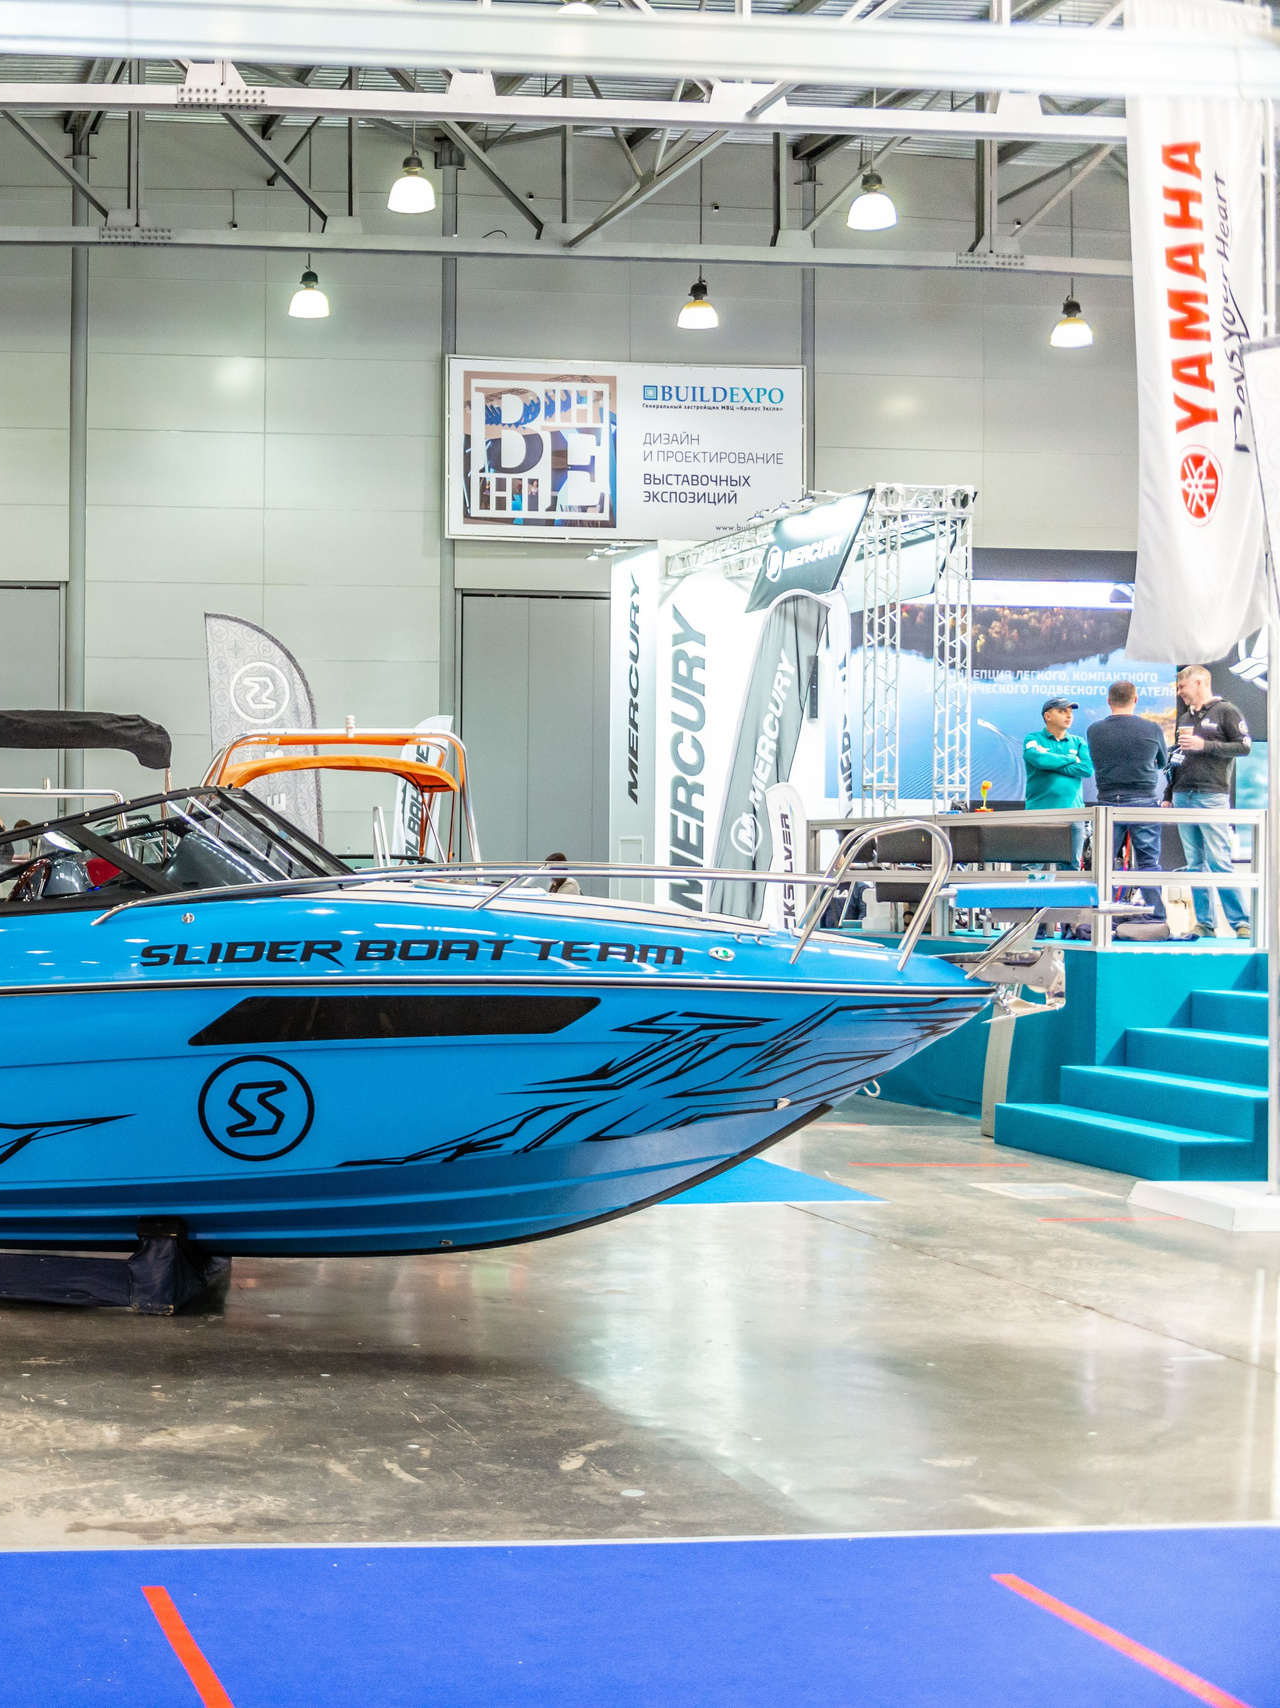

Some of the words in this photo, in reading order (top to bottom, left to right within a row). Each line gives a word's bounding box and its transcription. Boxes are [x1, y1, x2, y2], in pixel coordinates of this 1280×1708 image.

[1214, 169, 1231, 262] Heart
[1161, 141, 1219, 434] YAMAHA
[660, 385, 784, 404] BUILDEXPO
[643, 431, 700, 446] ДИЗАЙН
[643, 450, 653, 462] И
[657, 450, 783, 465] ПРОЕКТИРОВАНИЕ
[643, 473, 751, 487] ВЫСТАВОЧНЫХ
[643, 489, 738, 505] ЭКСПОЗИЦИЙ
[1073, 671, 1158, 683] КОМПАКТНОГО
[627, 571, 640, 805] MERCURY
[1032, 684, 1107, 697] ПОДВЕСНОГО
[749, 648, 796, 811] MERCURY
[669, 604, 706, 912] MERCURY
[140, 940, 345, 967] SLIDER
[355, 938, 515, 962] BOAT
[530, 939, 684, 966] TEAM
